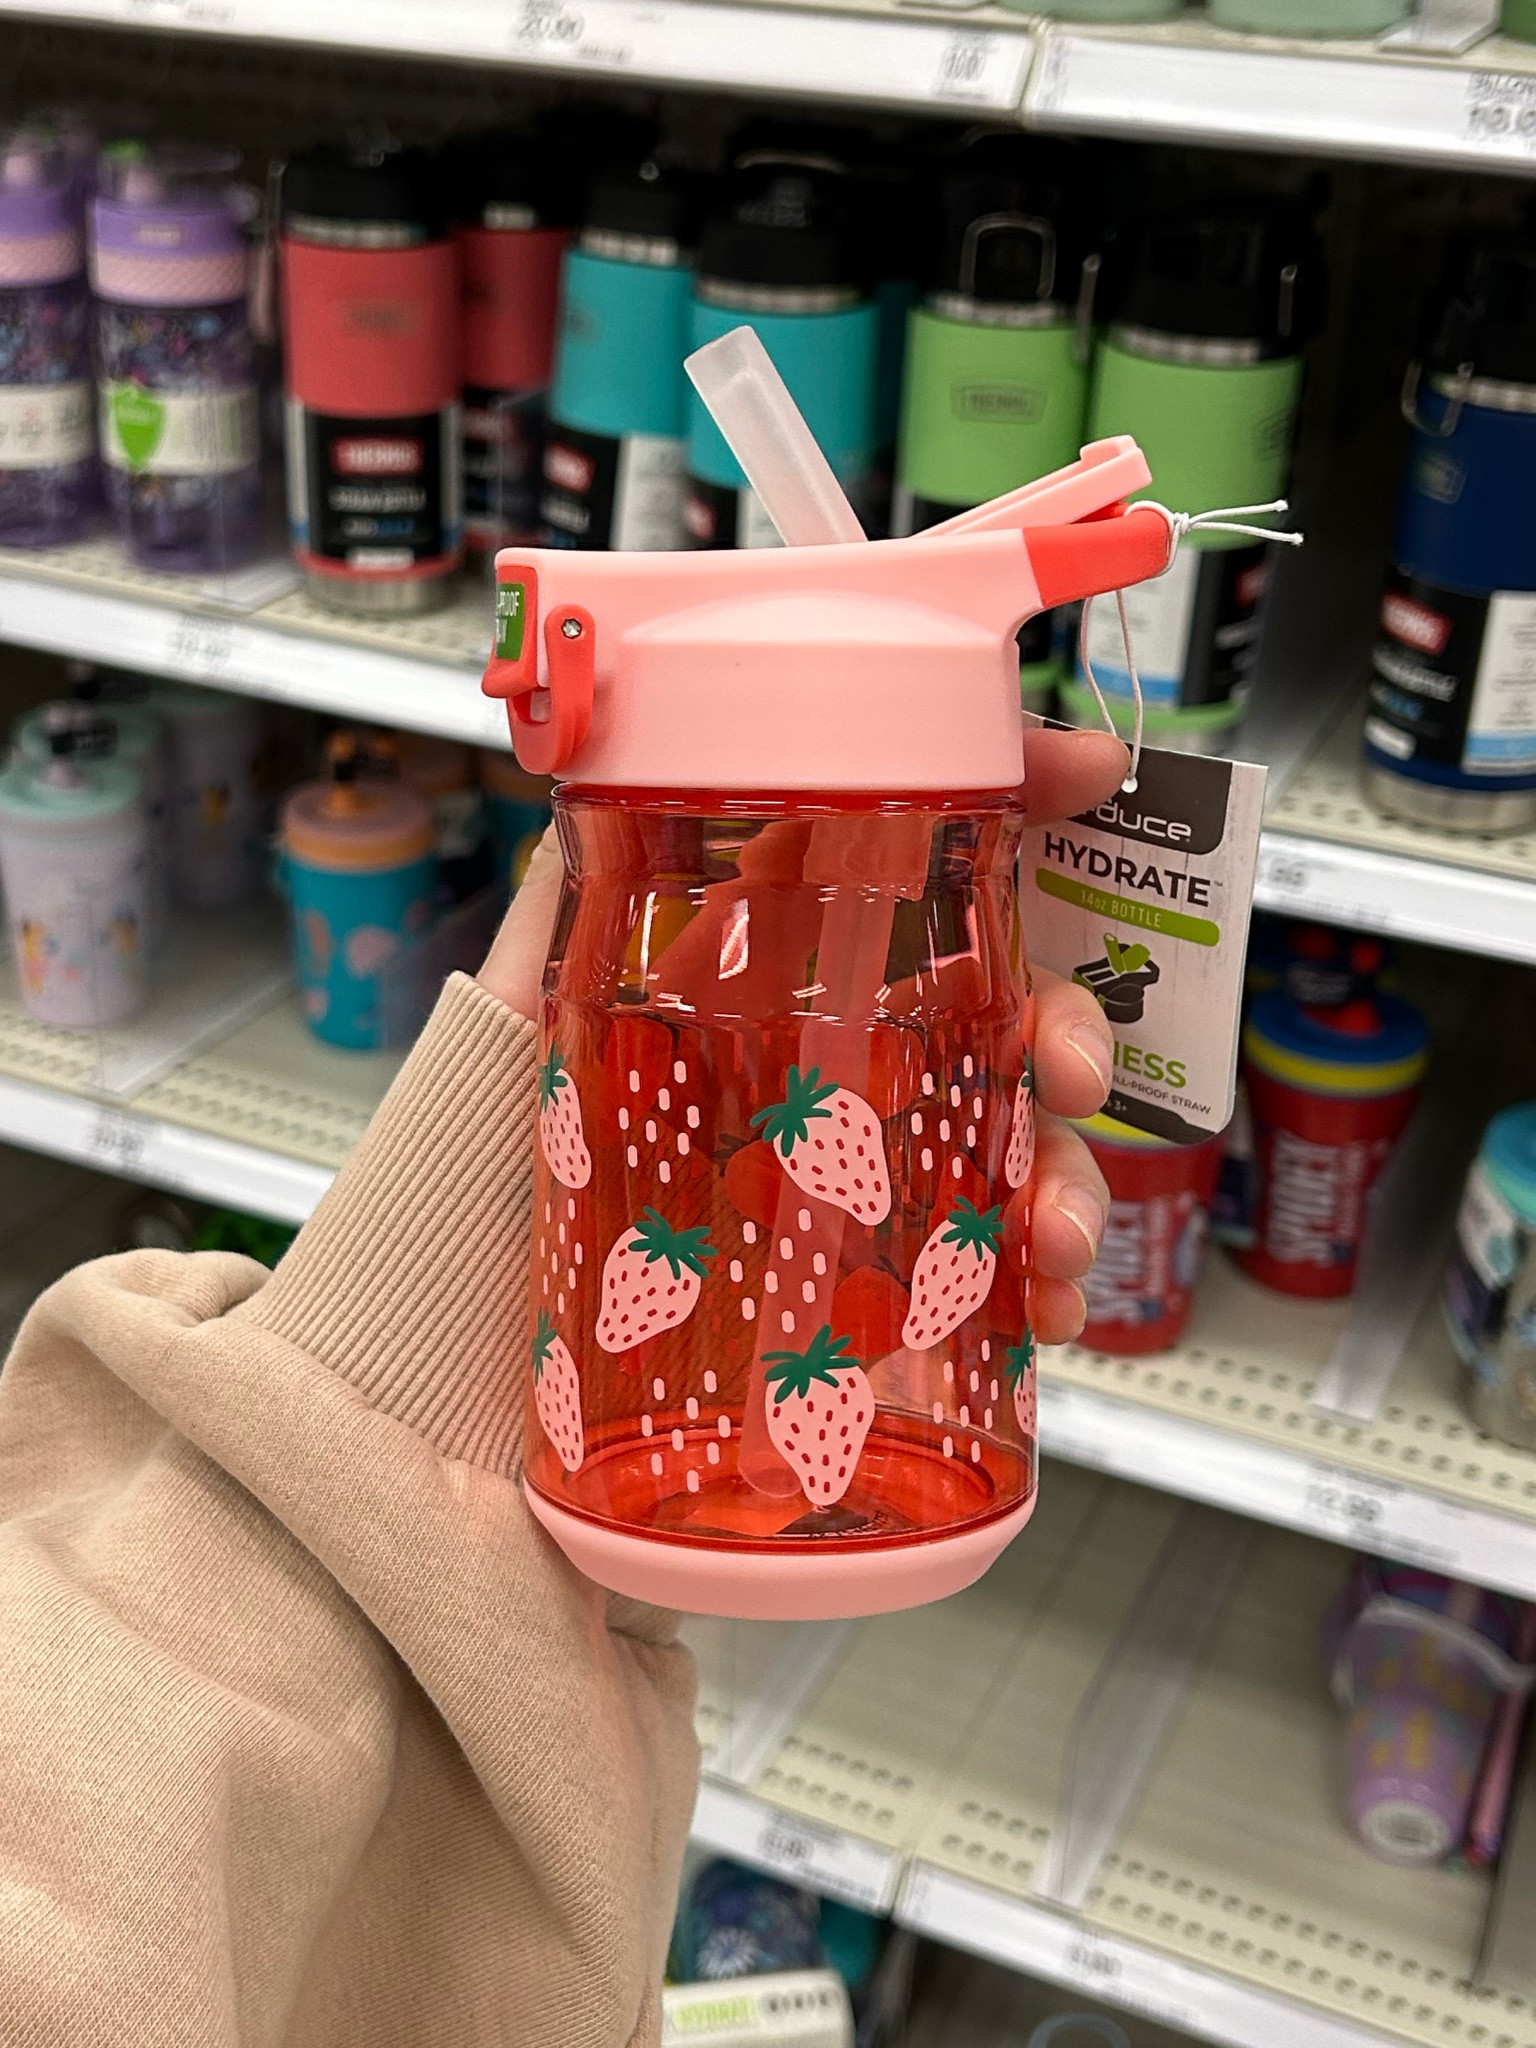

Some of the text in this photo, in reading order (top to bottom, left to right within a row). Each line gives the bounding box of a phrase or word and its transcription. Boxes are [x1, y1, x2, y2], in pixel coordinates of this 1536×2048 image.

[1082, 798, 1192, 841] duce
[1044, 831, 1211, 908] HYDRATE
[1081, 889, 1162, 929] 14oz BOTTLE
[1171, 1094, 1212, 1115] STRAW
